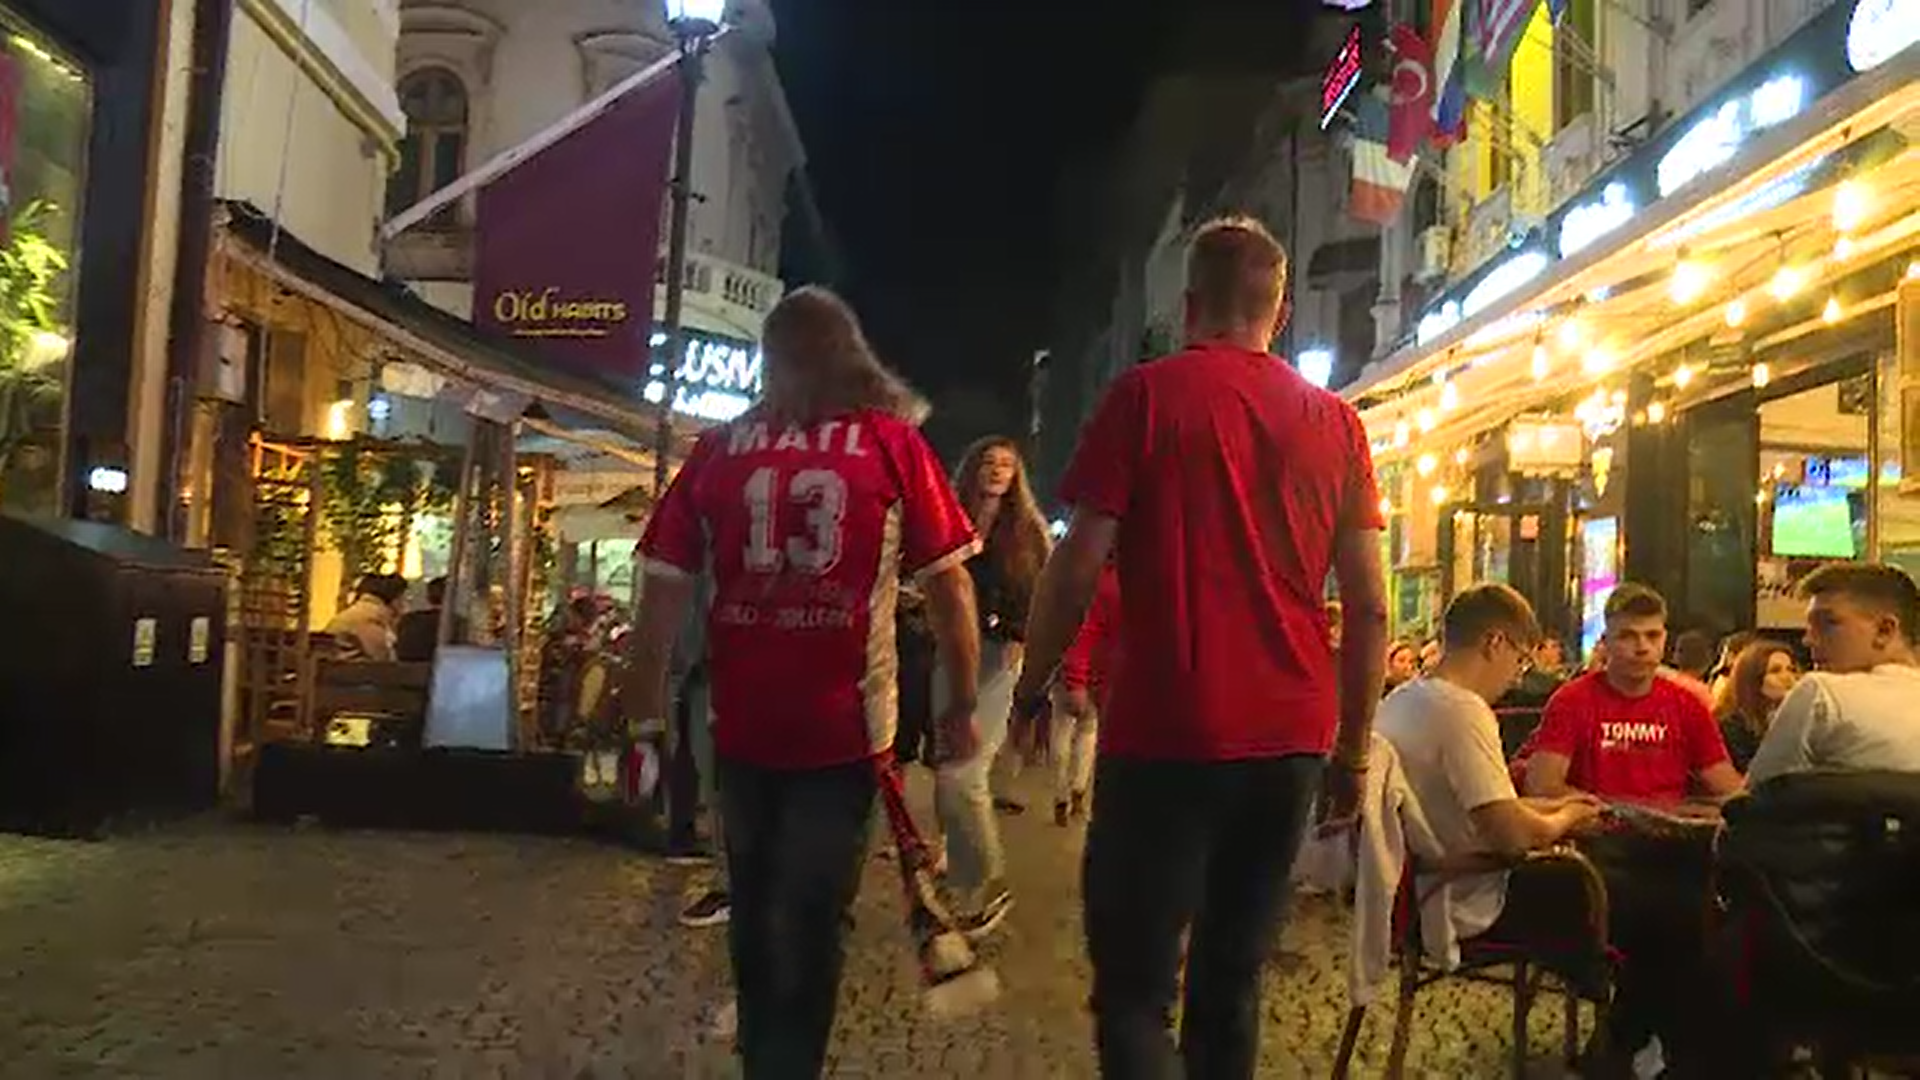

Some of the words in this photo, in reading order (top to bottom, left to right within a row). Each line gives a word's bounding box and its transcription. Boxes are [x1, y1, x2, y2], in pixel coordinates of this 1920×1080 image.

[495, 286, 559, 321] Old
[727, 421, 868, 457] MATL
[742, 466, 848, 575] 13
[1601, 721, 1669, 742] TOMMY
